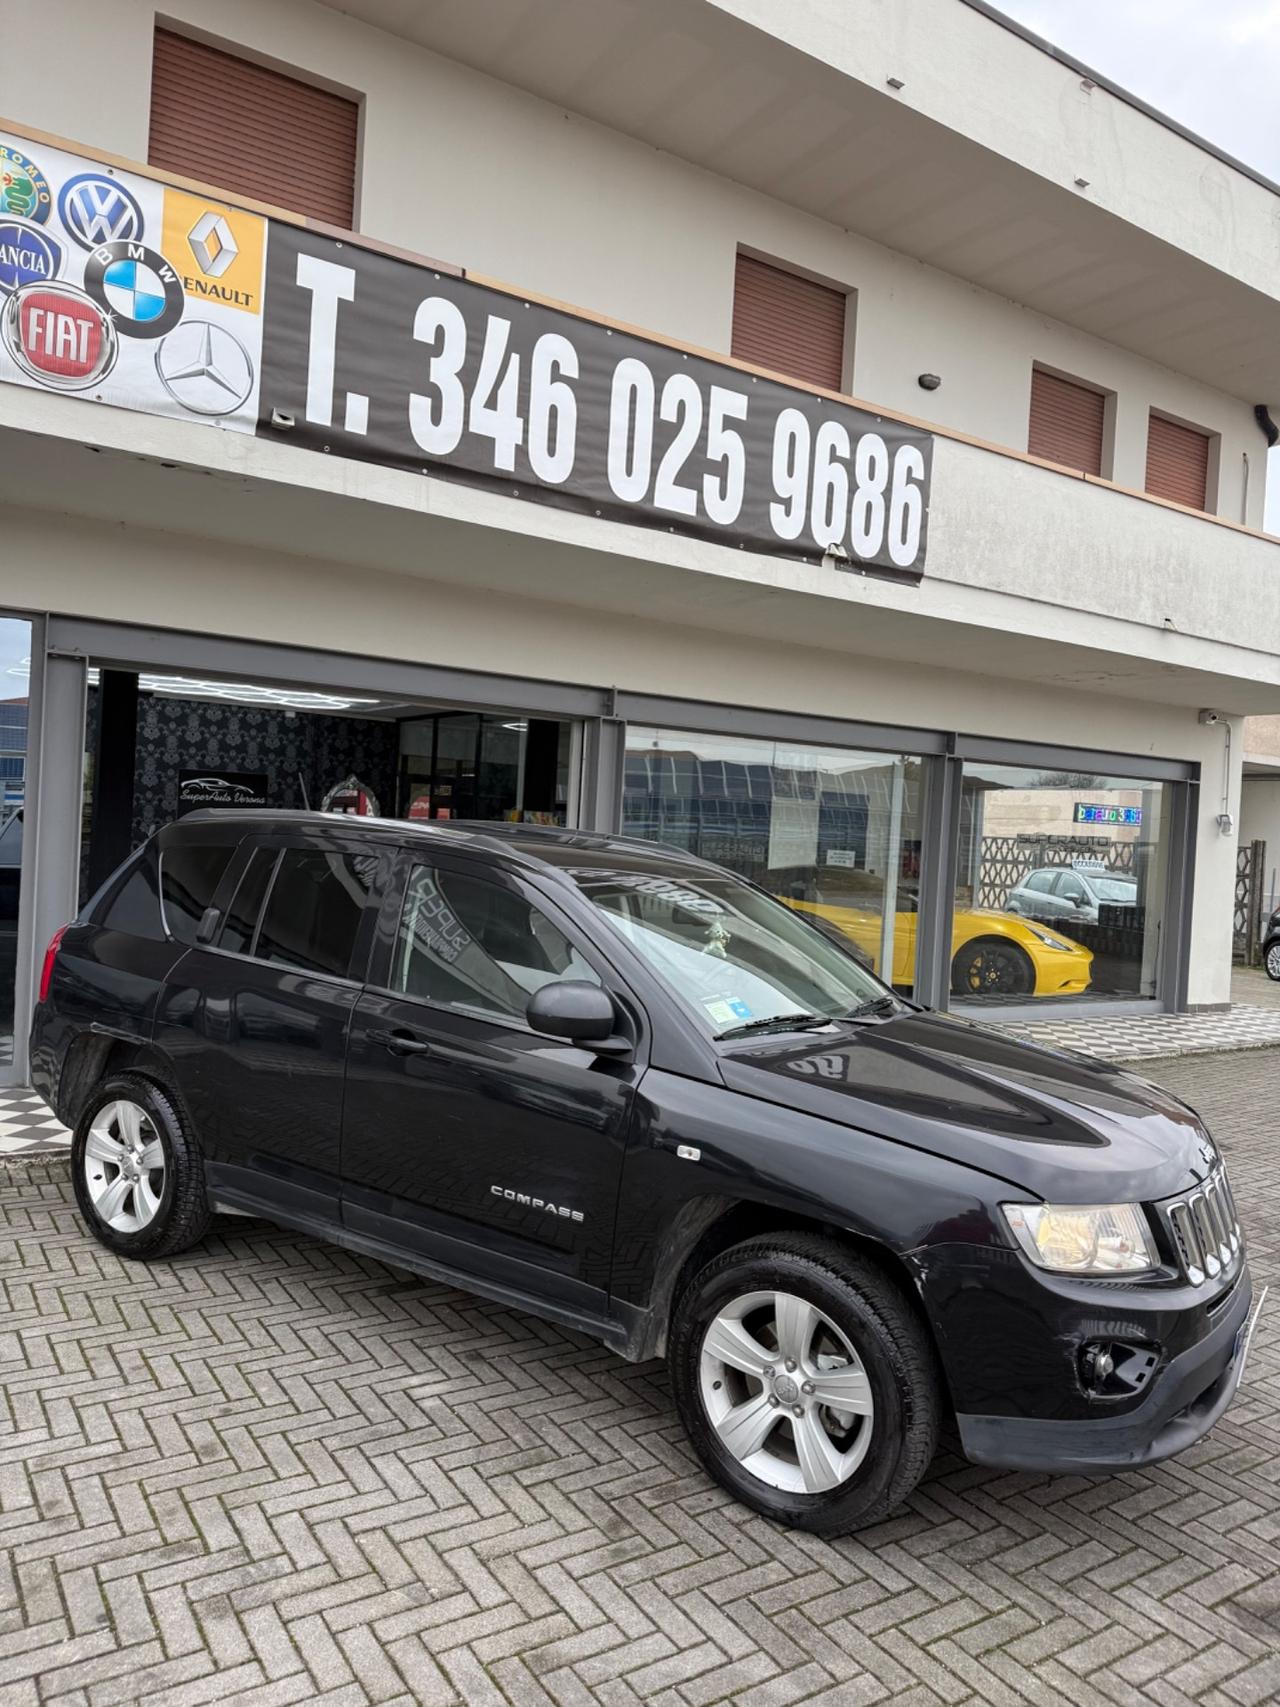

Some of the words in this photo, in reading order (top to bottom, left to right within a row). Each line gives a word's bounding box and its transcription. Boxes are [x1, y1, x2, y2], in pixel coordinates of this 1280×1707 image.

[0, 244, 46, 275] ANCIA
[96, 244, 176, 284] BMW
[180, 276, 253, 307] ENAULT
[28, 308, 94, 364] FIAT
[297, 252, 369, 435] T.
[408, 296, 579, 484] 346
[607, 358, 748, 525] 025
[769, 408, 924, 567] 9686
[490, 1185, 584, 1222] COMPASS
